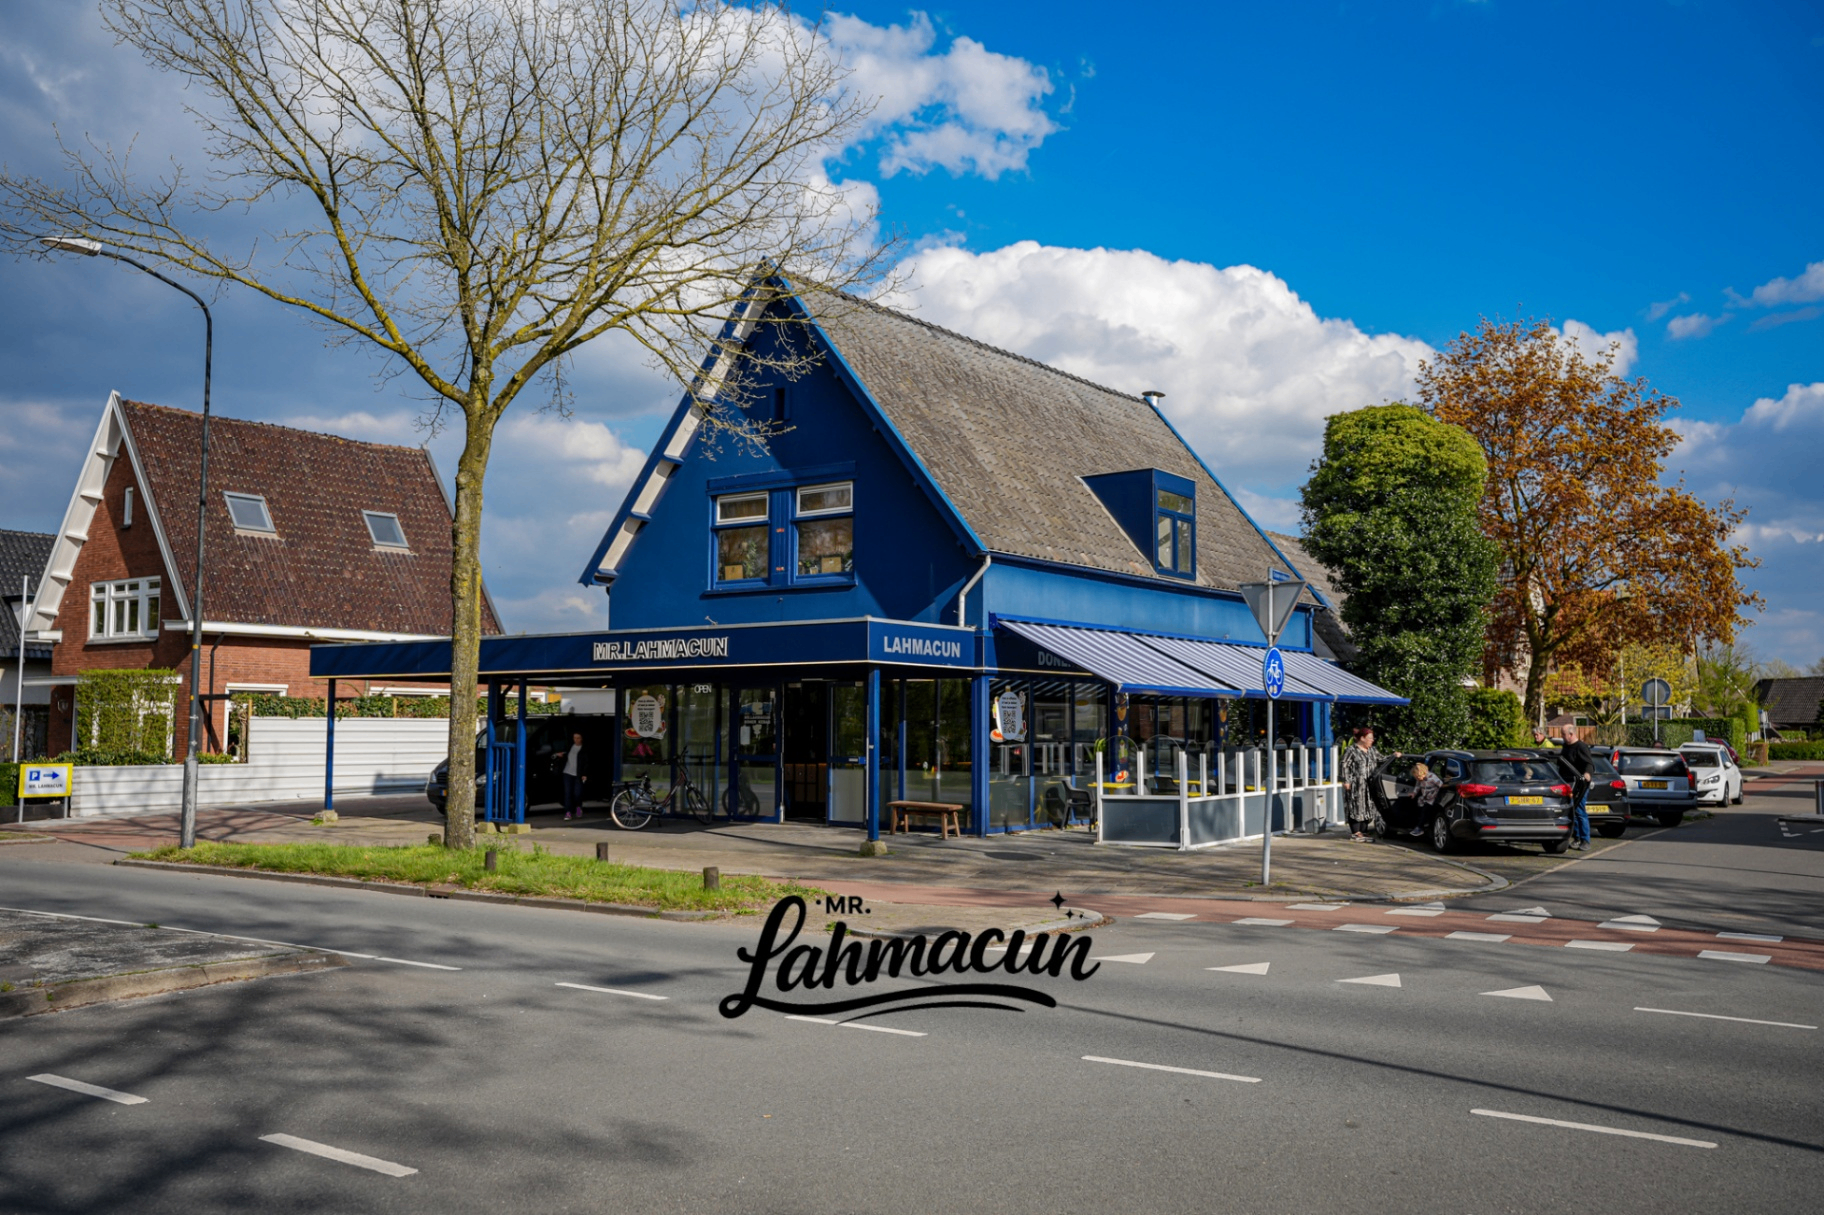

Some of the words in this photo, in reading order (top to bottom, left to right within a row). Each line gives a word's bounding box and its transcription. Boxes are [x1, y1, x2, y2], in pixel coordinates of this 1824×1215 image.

[593, 636, 729, 661] MR.LAHMACUN
[884, 636, 960, 658] LAHMACUN
[694, 685, 712, 694] OPEN
